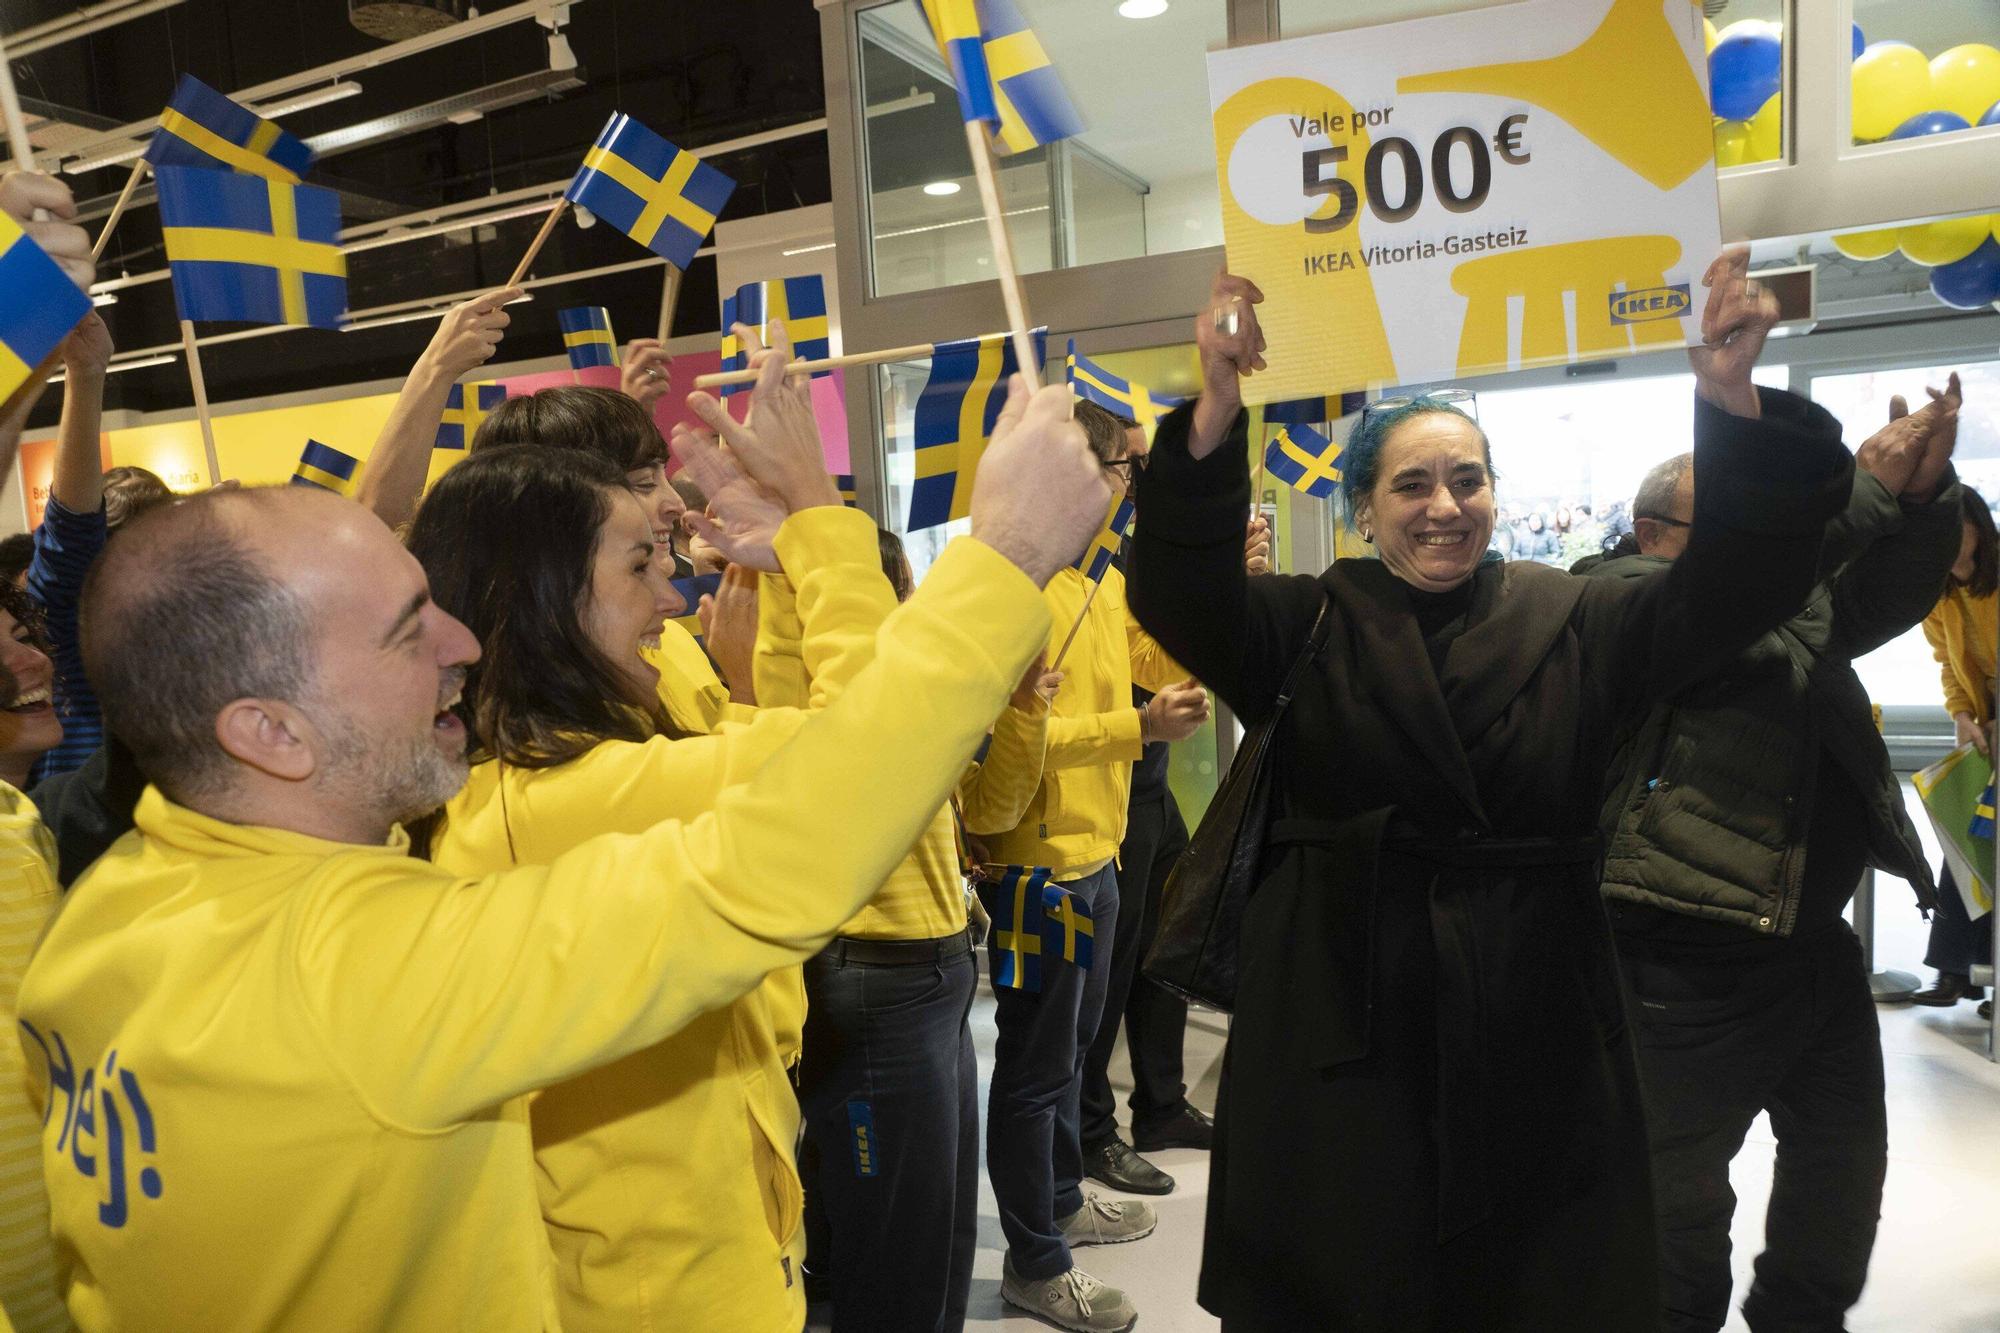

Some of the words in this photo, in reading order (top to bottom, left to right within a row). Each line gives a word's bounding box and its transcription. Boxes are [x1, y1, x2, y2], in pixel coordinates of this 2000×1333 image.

[1289, 112, 1345, 138] Vale
[1351, 106, 1394, 136] por
[1304, 251, 1355, 276] IKEA
[1359, 226, 1528, 267] Vitoria-Gasteiz
[1618, 294, 1685, 315] IKEA
[856, 1125, 871, 1173] IKEA
